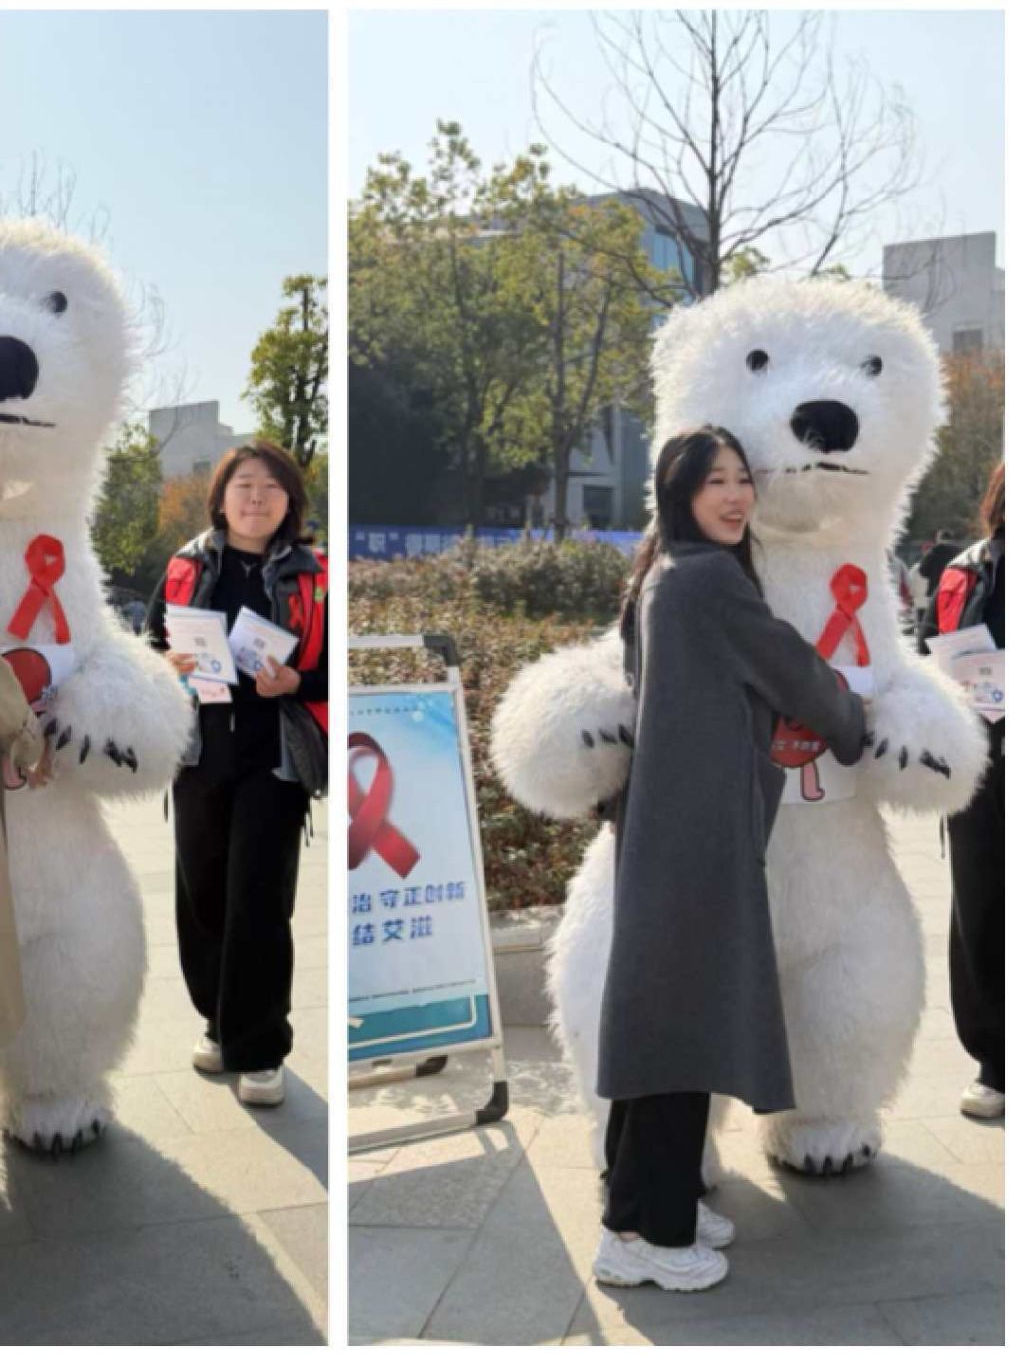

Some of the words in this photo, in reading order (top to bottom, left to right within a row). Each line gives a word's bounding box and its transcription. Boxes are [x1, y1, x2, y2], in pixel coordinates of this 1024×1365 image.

[378, 880, 466, 908] 守正创新
[352, 914, 433, 947] 结艾滋
